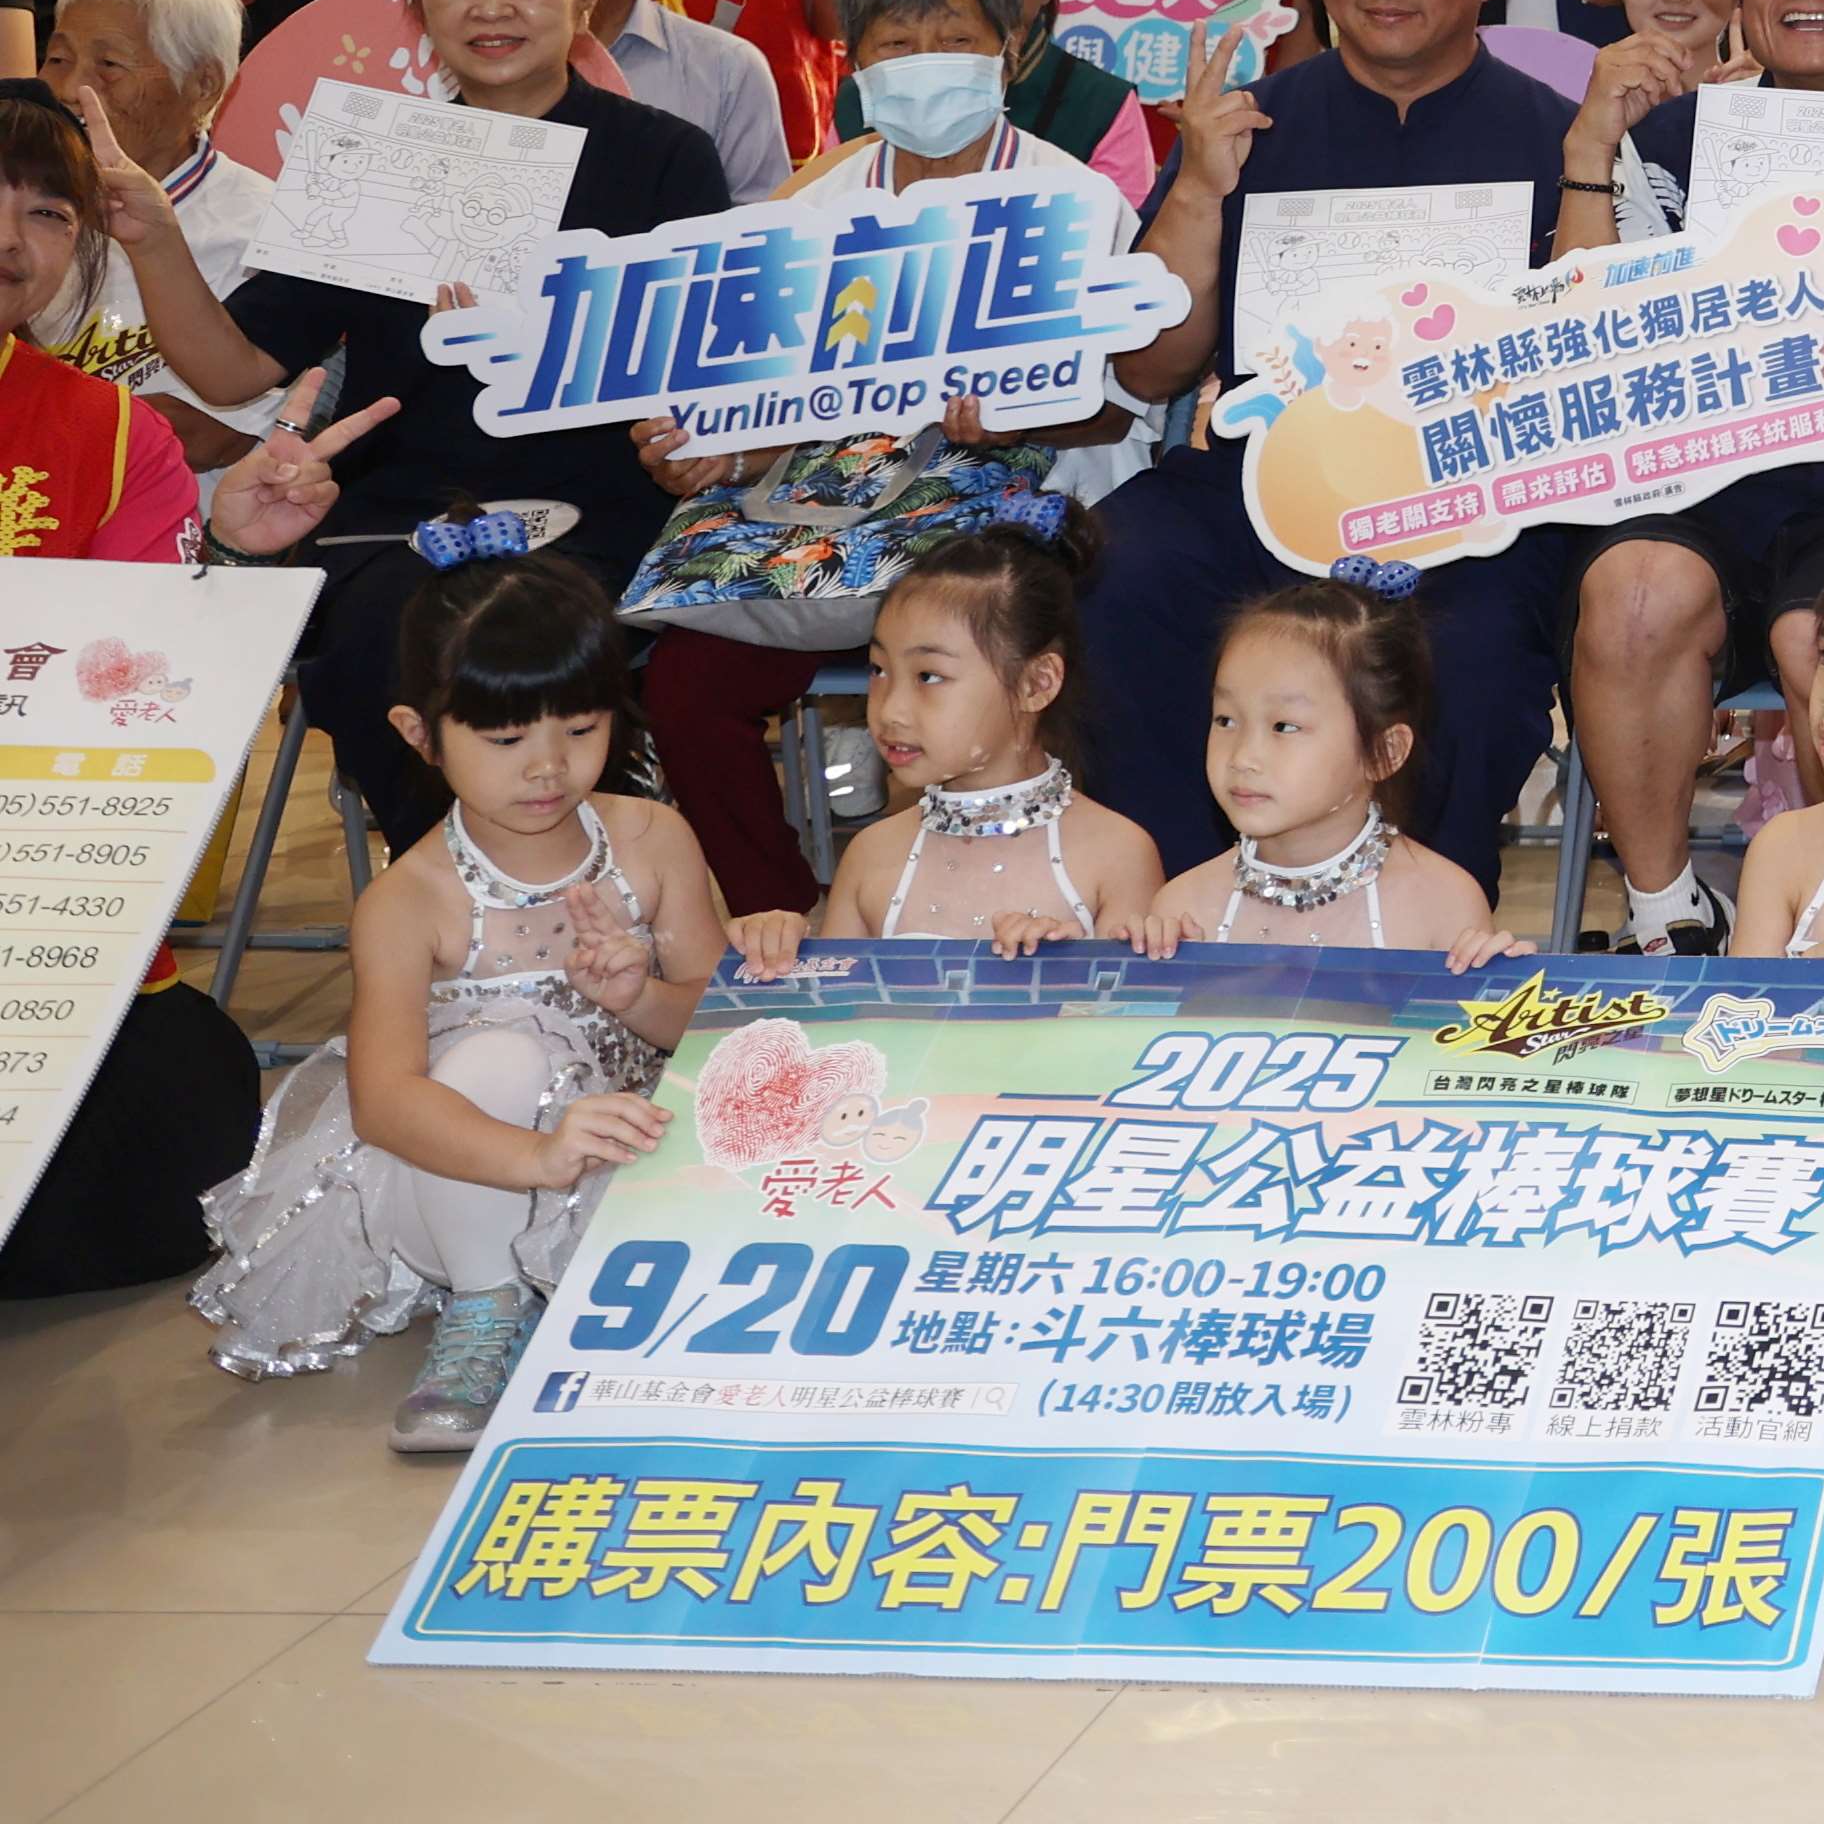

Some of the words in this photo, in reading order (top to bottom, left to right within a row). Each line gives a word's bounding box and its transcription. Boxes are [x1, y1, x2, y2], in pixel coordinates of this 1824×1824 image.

[1603, 246, 1696, 288] 加速前進
[500, 191, 1112, 416] 加速前進
[667, 378, 926, 438] Yunlin@Top
[941, 350, 1082, 415] Speed
[1501, 459, 1607, 509] 需求評估
[1347, 488, 1482, 545] 獨老關支持
[109, 697, 178, 728] 愛老人
[1437, 983, 1669, 1046] Artist
[1520, 1025, 1591, 1055] Star
[1122, 1032, 1410, 1112] 2025
[1433, 1075, 1632, 1100] 台灣閃亮之星棒球隊
[757, 1156, 897, 1219] 愛老人
[569, 1240, 910, 1358] 9/20
[917, 1250, 1075, 1297] 星期六
[1091, 1255, 1387, 1302] 16:00-19:00
[1398, 1406, 1514, 1436] 雲林粉專
[1546, 1412, 1665, 1440] 線上捐款
[1695, 1415, 1813, 1445] 活動官網
